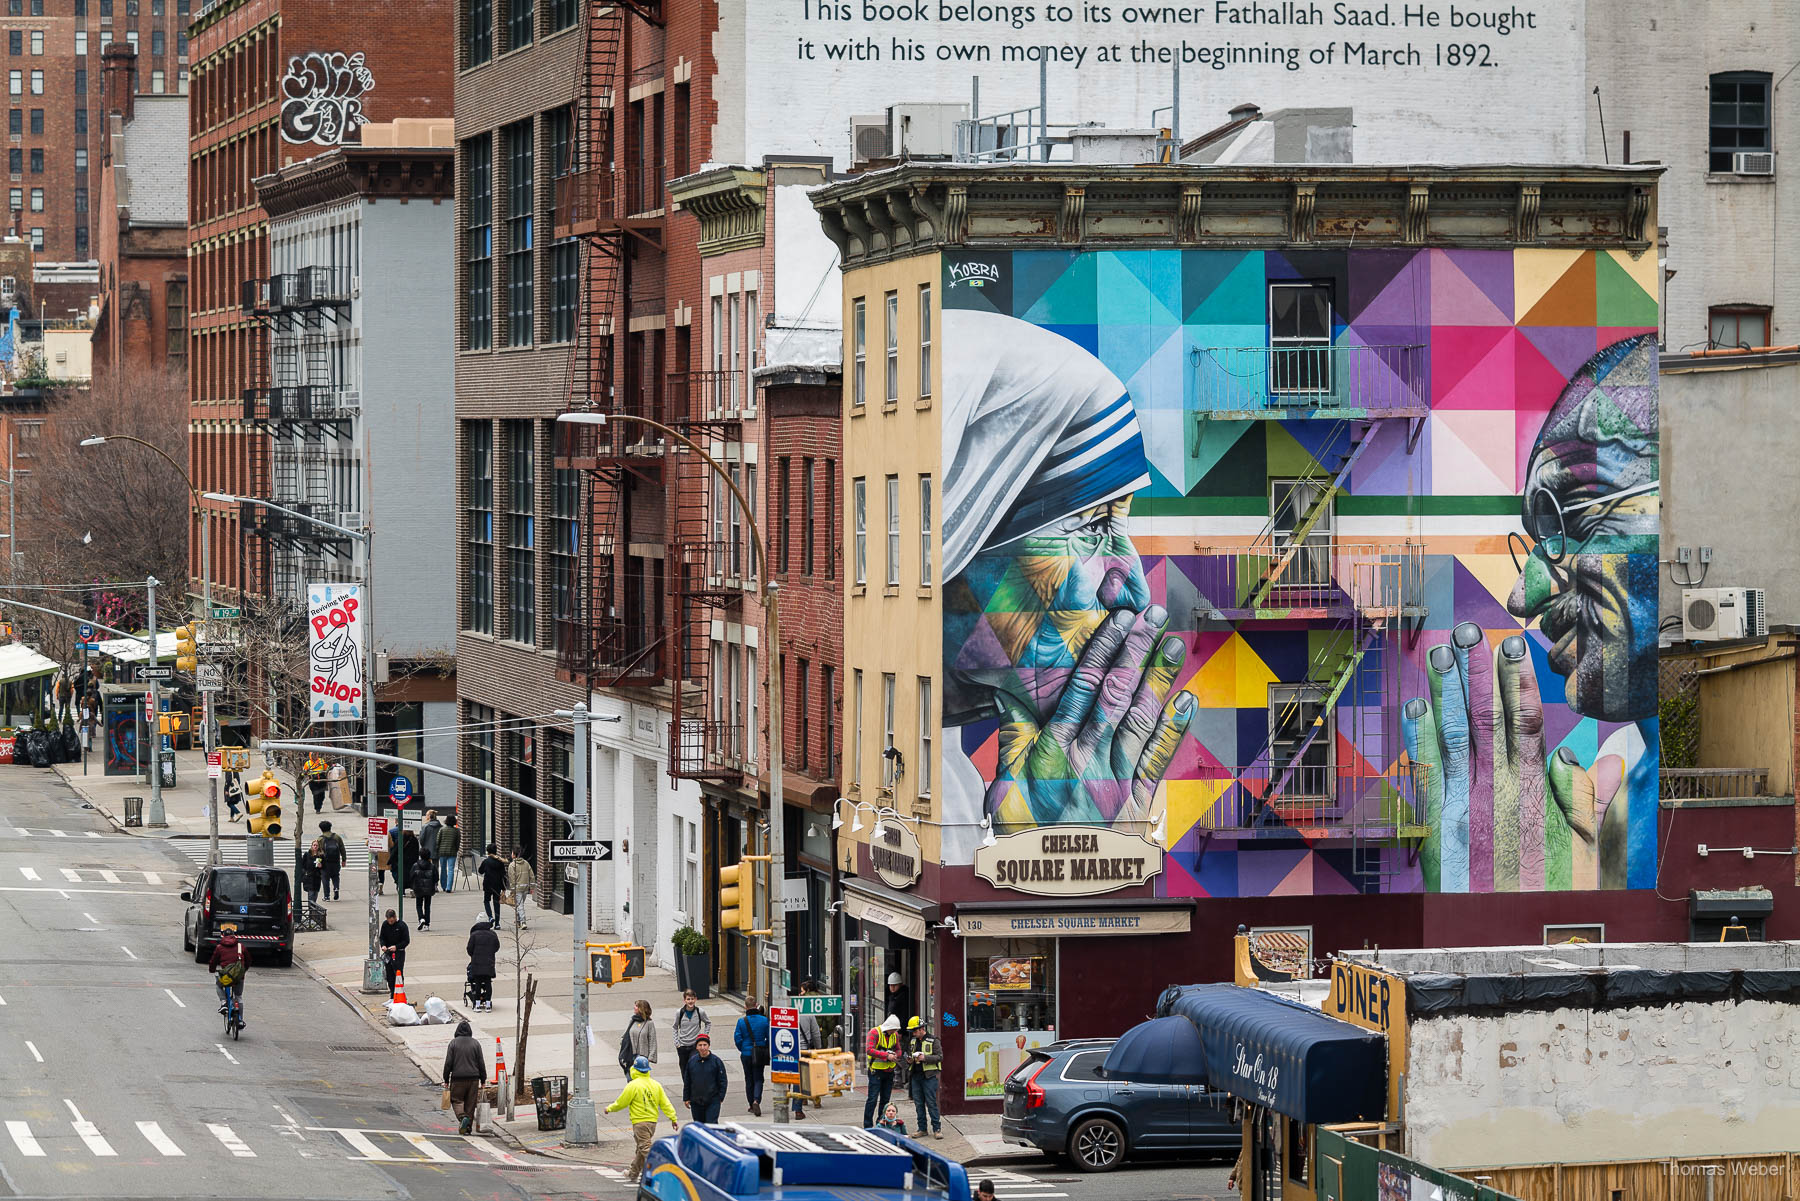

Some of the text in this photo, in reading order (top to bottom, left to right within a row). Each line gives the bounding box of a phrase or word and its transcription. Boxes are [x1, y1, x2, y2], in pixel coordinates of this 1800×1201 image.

[804, 0, 1537, 35] This book belongs to its owner Fathallah Saad. He bought
[798, 36, 1500, 71] it with his own money at the beginning of March 1892.
[949, 262, 999, 280] KOBRA
[214, 608, 221, 617] W
[222, 608, 230, 617] 19
[310, 593, 350, 617] Reviving the
[311, 598, 359, 640] POP
[203, 669, 215, 677] NO
[311, 676, 362, 704] SHOP
[559, 846, 604, 856] ONE WAY
[1041, 834, 1099, 854] CHELSEA
[996, 857, 1145, 885] SQUARE MARKET
[967, 916, 1141, 931] 130 CHELSEA SQUARE MARKET
[794, 998, 837, 1013] W 18 ST
[1336, 966, 1390, 1030] DINER
[774, 1014, 795, 1022] STANDING
[1232, 1043, 1279, 1090] Star On 18
